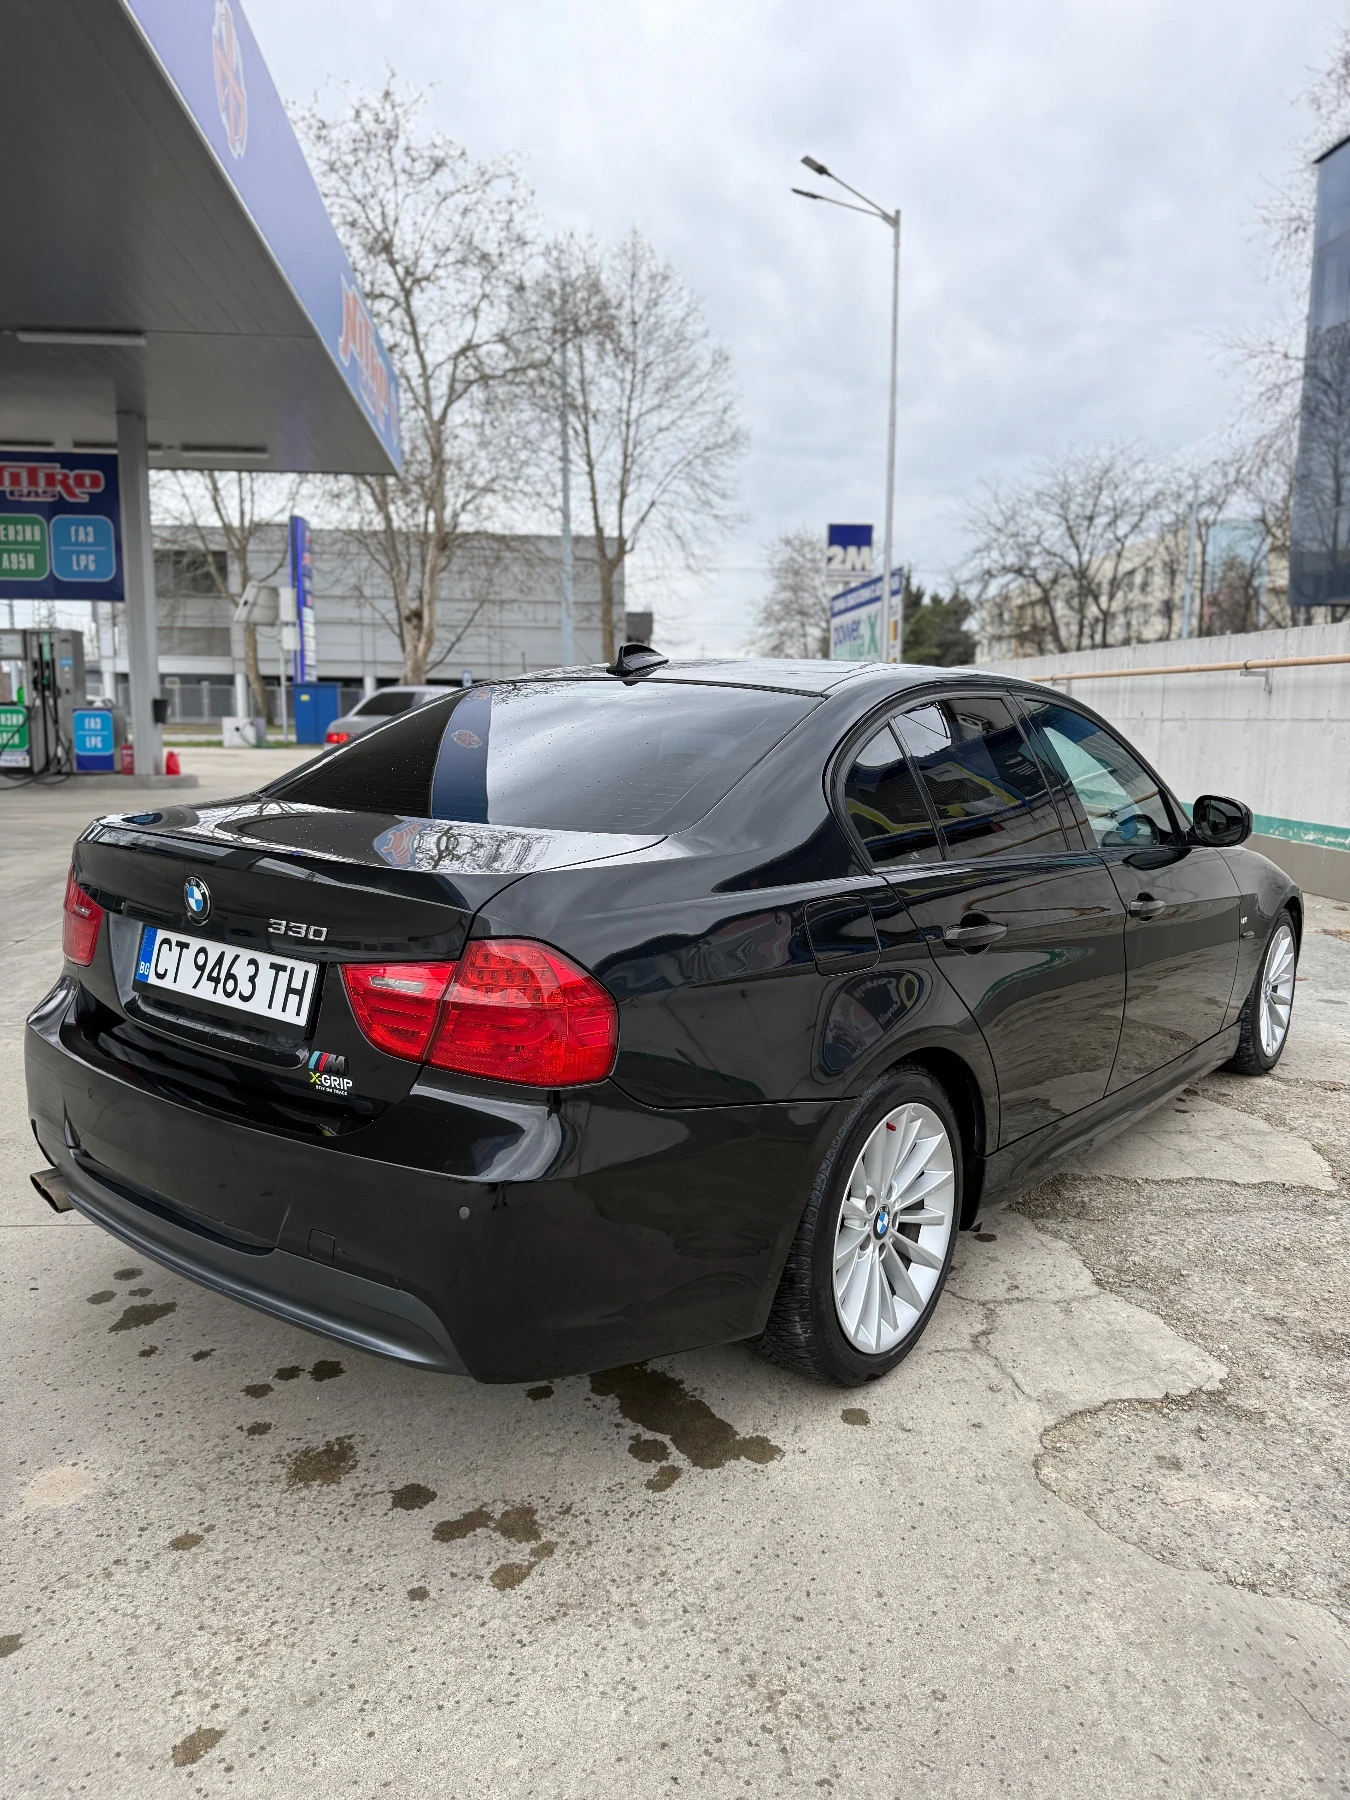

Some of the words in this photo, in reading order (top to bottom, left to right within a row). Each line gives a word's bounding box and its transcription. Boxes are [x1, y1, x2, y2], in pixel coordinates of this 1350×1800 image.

[70, 526, 94, 543] ГАЗ
[72, 554, 96, 571] LPG
[827, 544, 872, 571] 2M
[267, 918, 328, 942] 330
[139, 961, 150, 976] BG
[154, 937, 190, 984] CT
[191, 946, 260, 1003] 9463
[267, 961, 310, 1017] TH
[308, 1071, 353, 1091] X-GRIP
